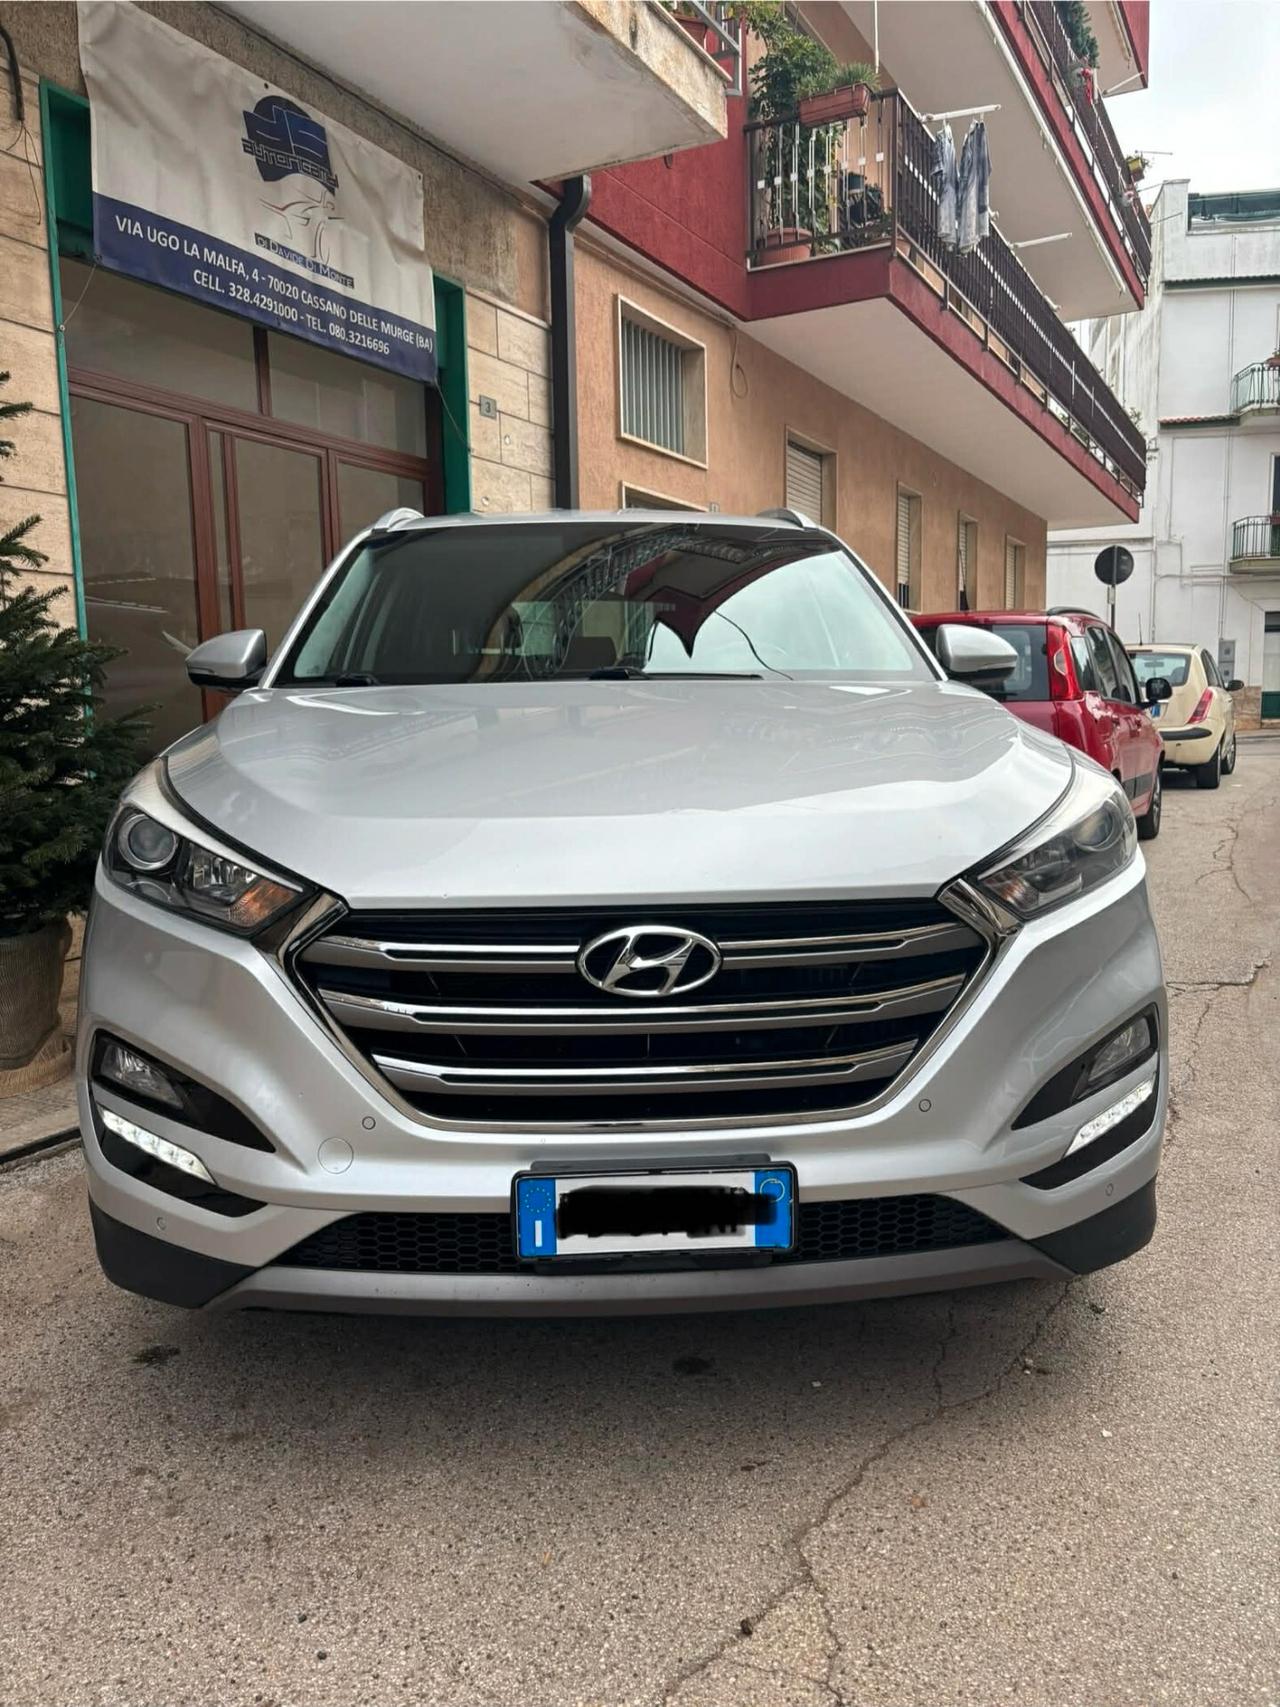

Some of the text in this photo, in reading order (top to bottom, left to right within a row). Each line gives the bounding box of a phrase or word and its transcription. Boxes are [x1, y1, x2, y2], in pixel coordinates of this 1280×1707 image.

[115, 215, 143, 239] VIA
[147, 226, 180, 251] UGO
[184, 240, 200, 259] LA
[204, 247, 249, 281] MALFA,
[252, 269, 259, 282] 4
[268, 275, 299, 300] 70020
[301, 290, 347, 319] CASSANO
[350, 310, 378, 331] DELLE
[381, 321, 414, 344] MURGE
[416, 333, 432, 353] (BA)
[193, 269, 225, 293] CELL.
[229, 283, 298, 321] 328.4291000
[306, 314, 327, 333] TEL.
[329, 323, 390, 355] 080.3216696
[484, 401, 491, 414] 3
